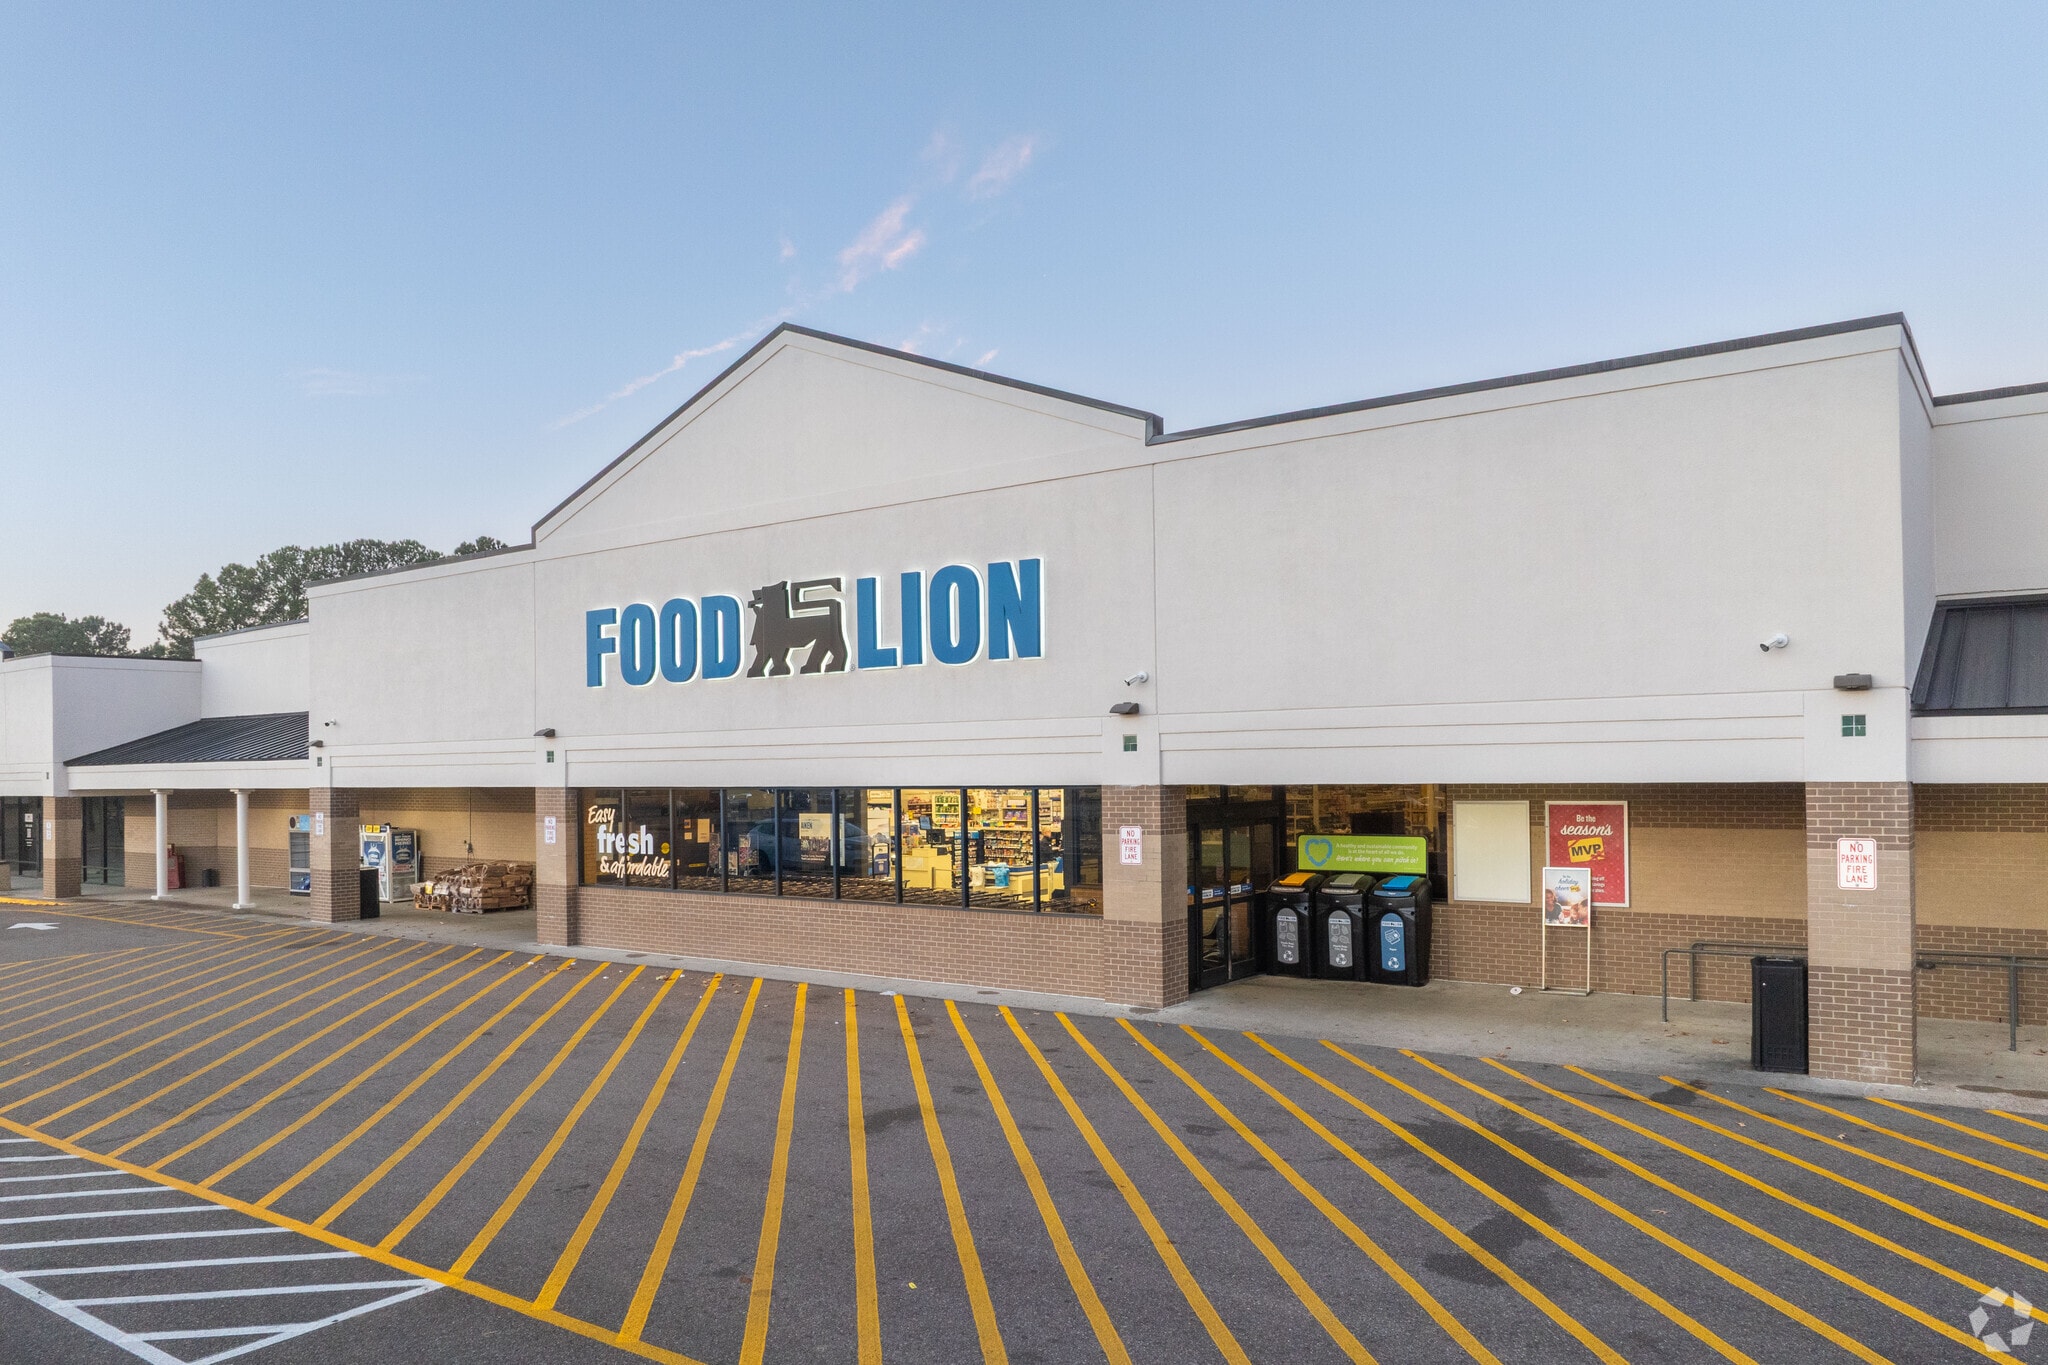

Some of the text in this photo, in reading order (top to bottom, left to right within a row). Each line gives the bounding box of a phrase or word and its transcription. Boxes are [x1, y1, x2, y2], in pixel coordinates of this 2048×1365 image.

[586, 557, 1047, 688] FOOD LION
[588, 805, 615, 832] Easy
[1576, 814, 1585, 822] Be
[1560, 824, 1613, 836] season's
[597, 824, 654, 854] fresh
[1571, 844, 1602, 856] MVP
[1850, 844, 1864, 852] NO
[1841, 855, 1872, 864] PARKING
[1847, 866, 1867, 874] FIRE
[1846, 875, 1868, 883] LANE
